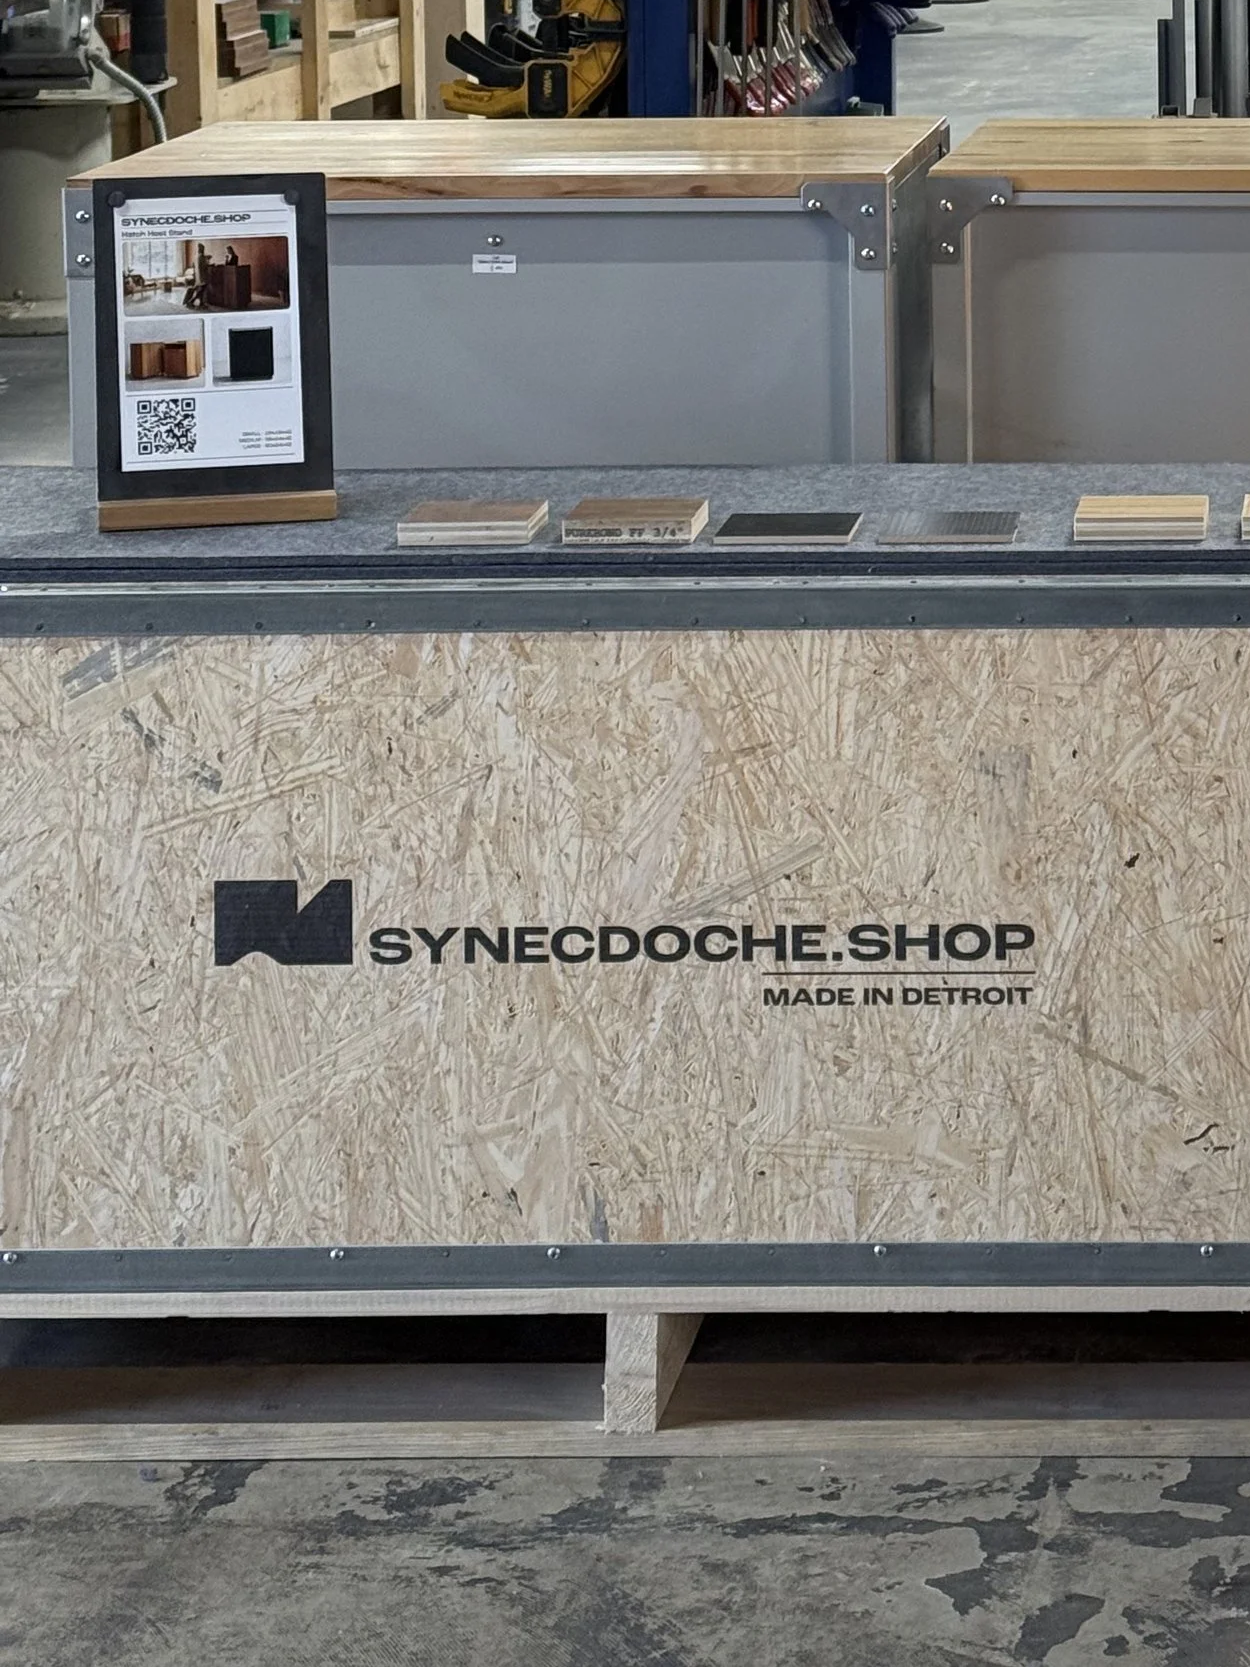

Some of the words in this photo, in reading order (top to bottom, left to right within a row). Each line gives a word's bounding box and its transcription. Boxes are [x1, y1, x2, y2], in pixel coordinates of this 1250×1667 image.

[121, 214, 251, 227] SYNECDOCHE.SHOP
[369, 922, 1036, 965] SYNECDOCHE.SHOP
[762, 986, 854, 1007] MADE
[863, 986, 896, 1007] IN
[903, 986, 1034, 1007] DETROIT
